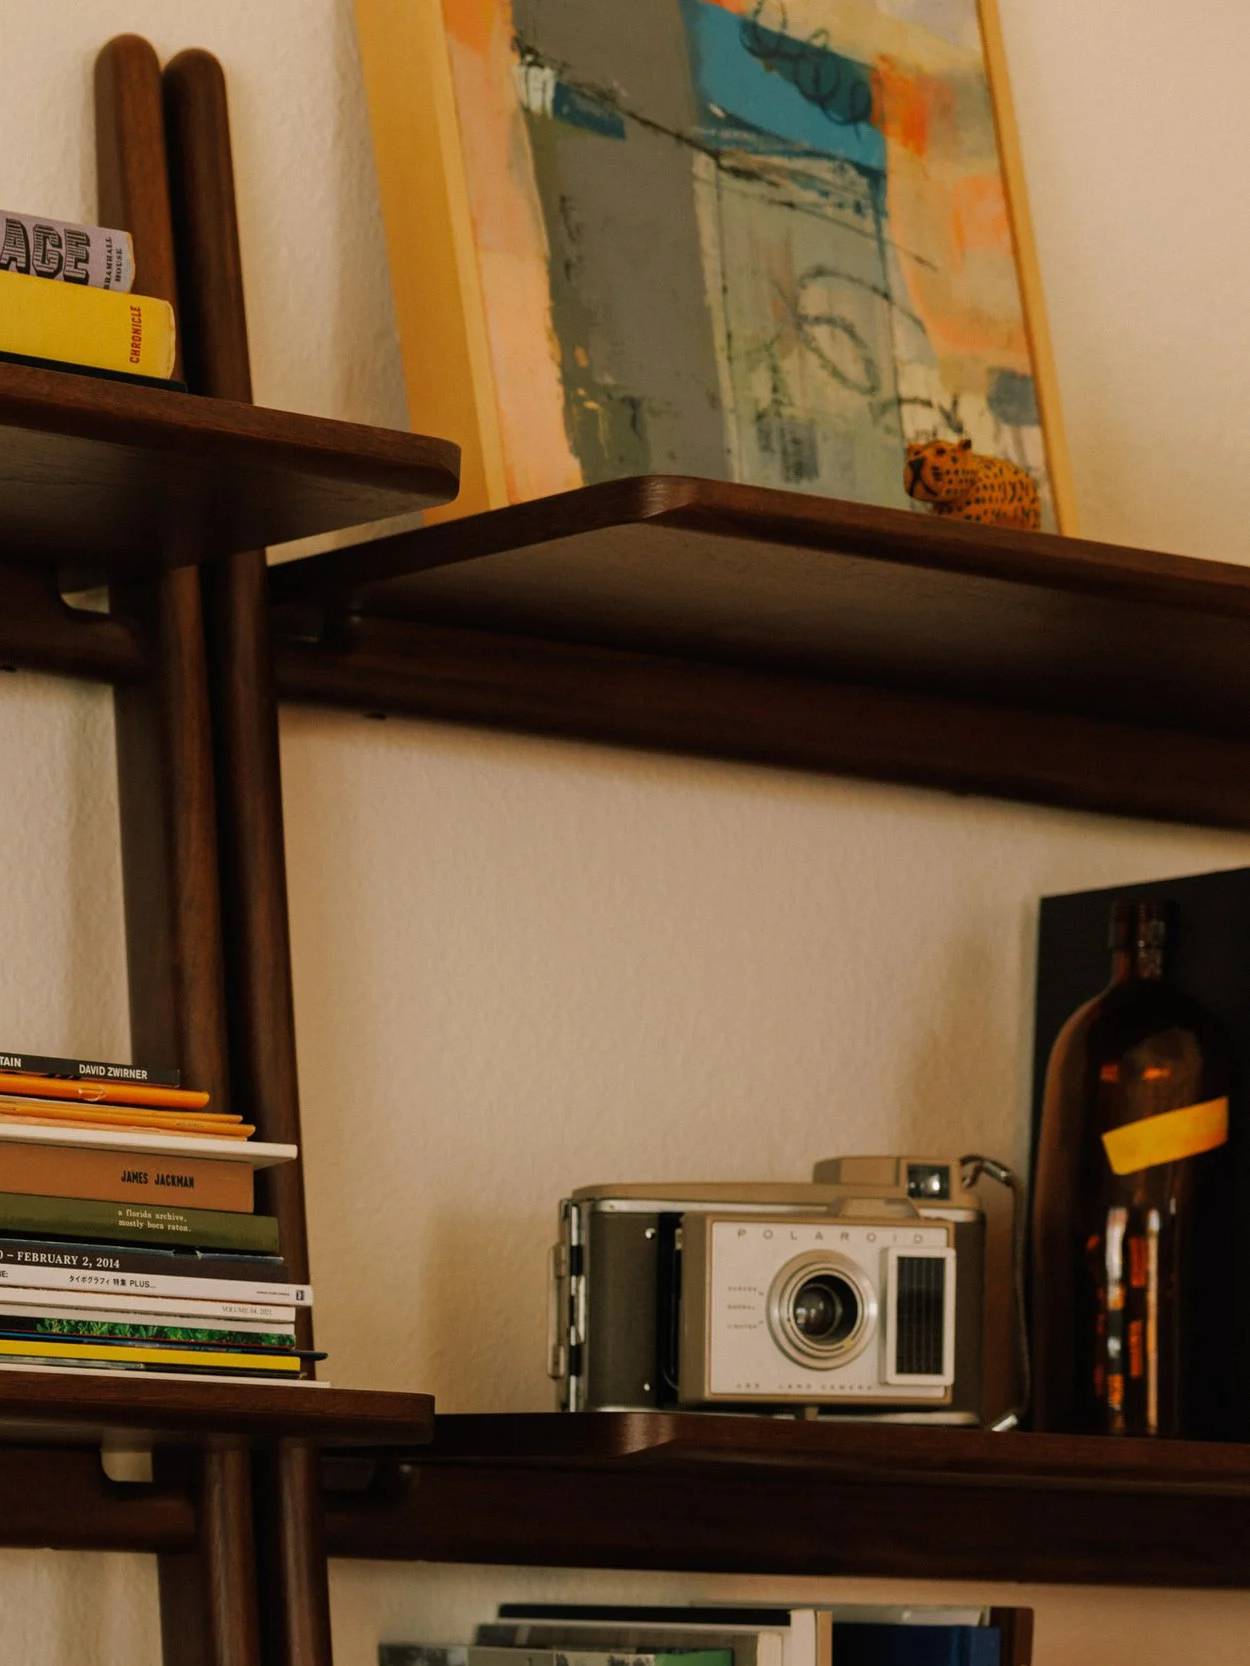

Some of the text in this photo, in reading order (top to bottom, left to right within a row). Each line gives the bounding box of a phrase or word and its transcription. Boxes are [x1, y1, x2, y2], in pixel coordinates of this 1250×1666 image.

[114, 248, 123, 283] HOUSE
[129, 305, 143, 364] CHRONICLE
[79, 1064, 105, 1076] DAVID
[107, 1067, 148, 1080] ZWIRNER
[121, 1171, 195, 1188] JAMES JACKMAN
[126, 1208, 152, 1219] florida
[118, 1219, 144, 1229] mostly
[147, 1221, 164, 1230] boca
[738, 1229, 924, 1245] POLAROID
[17, 1251, 78, 1266] FEBRUARY
[82, 1256, 92, 1268] 2,
[96, 1257, 120, 1269] 2014
